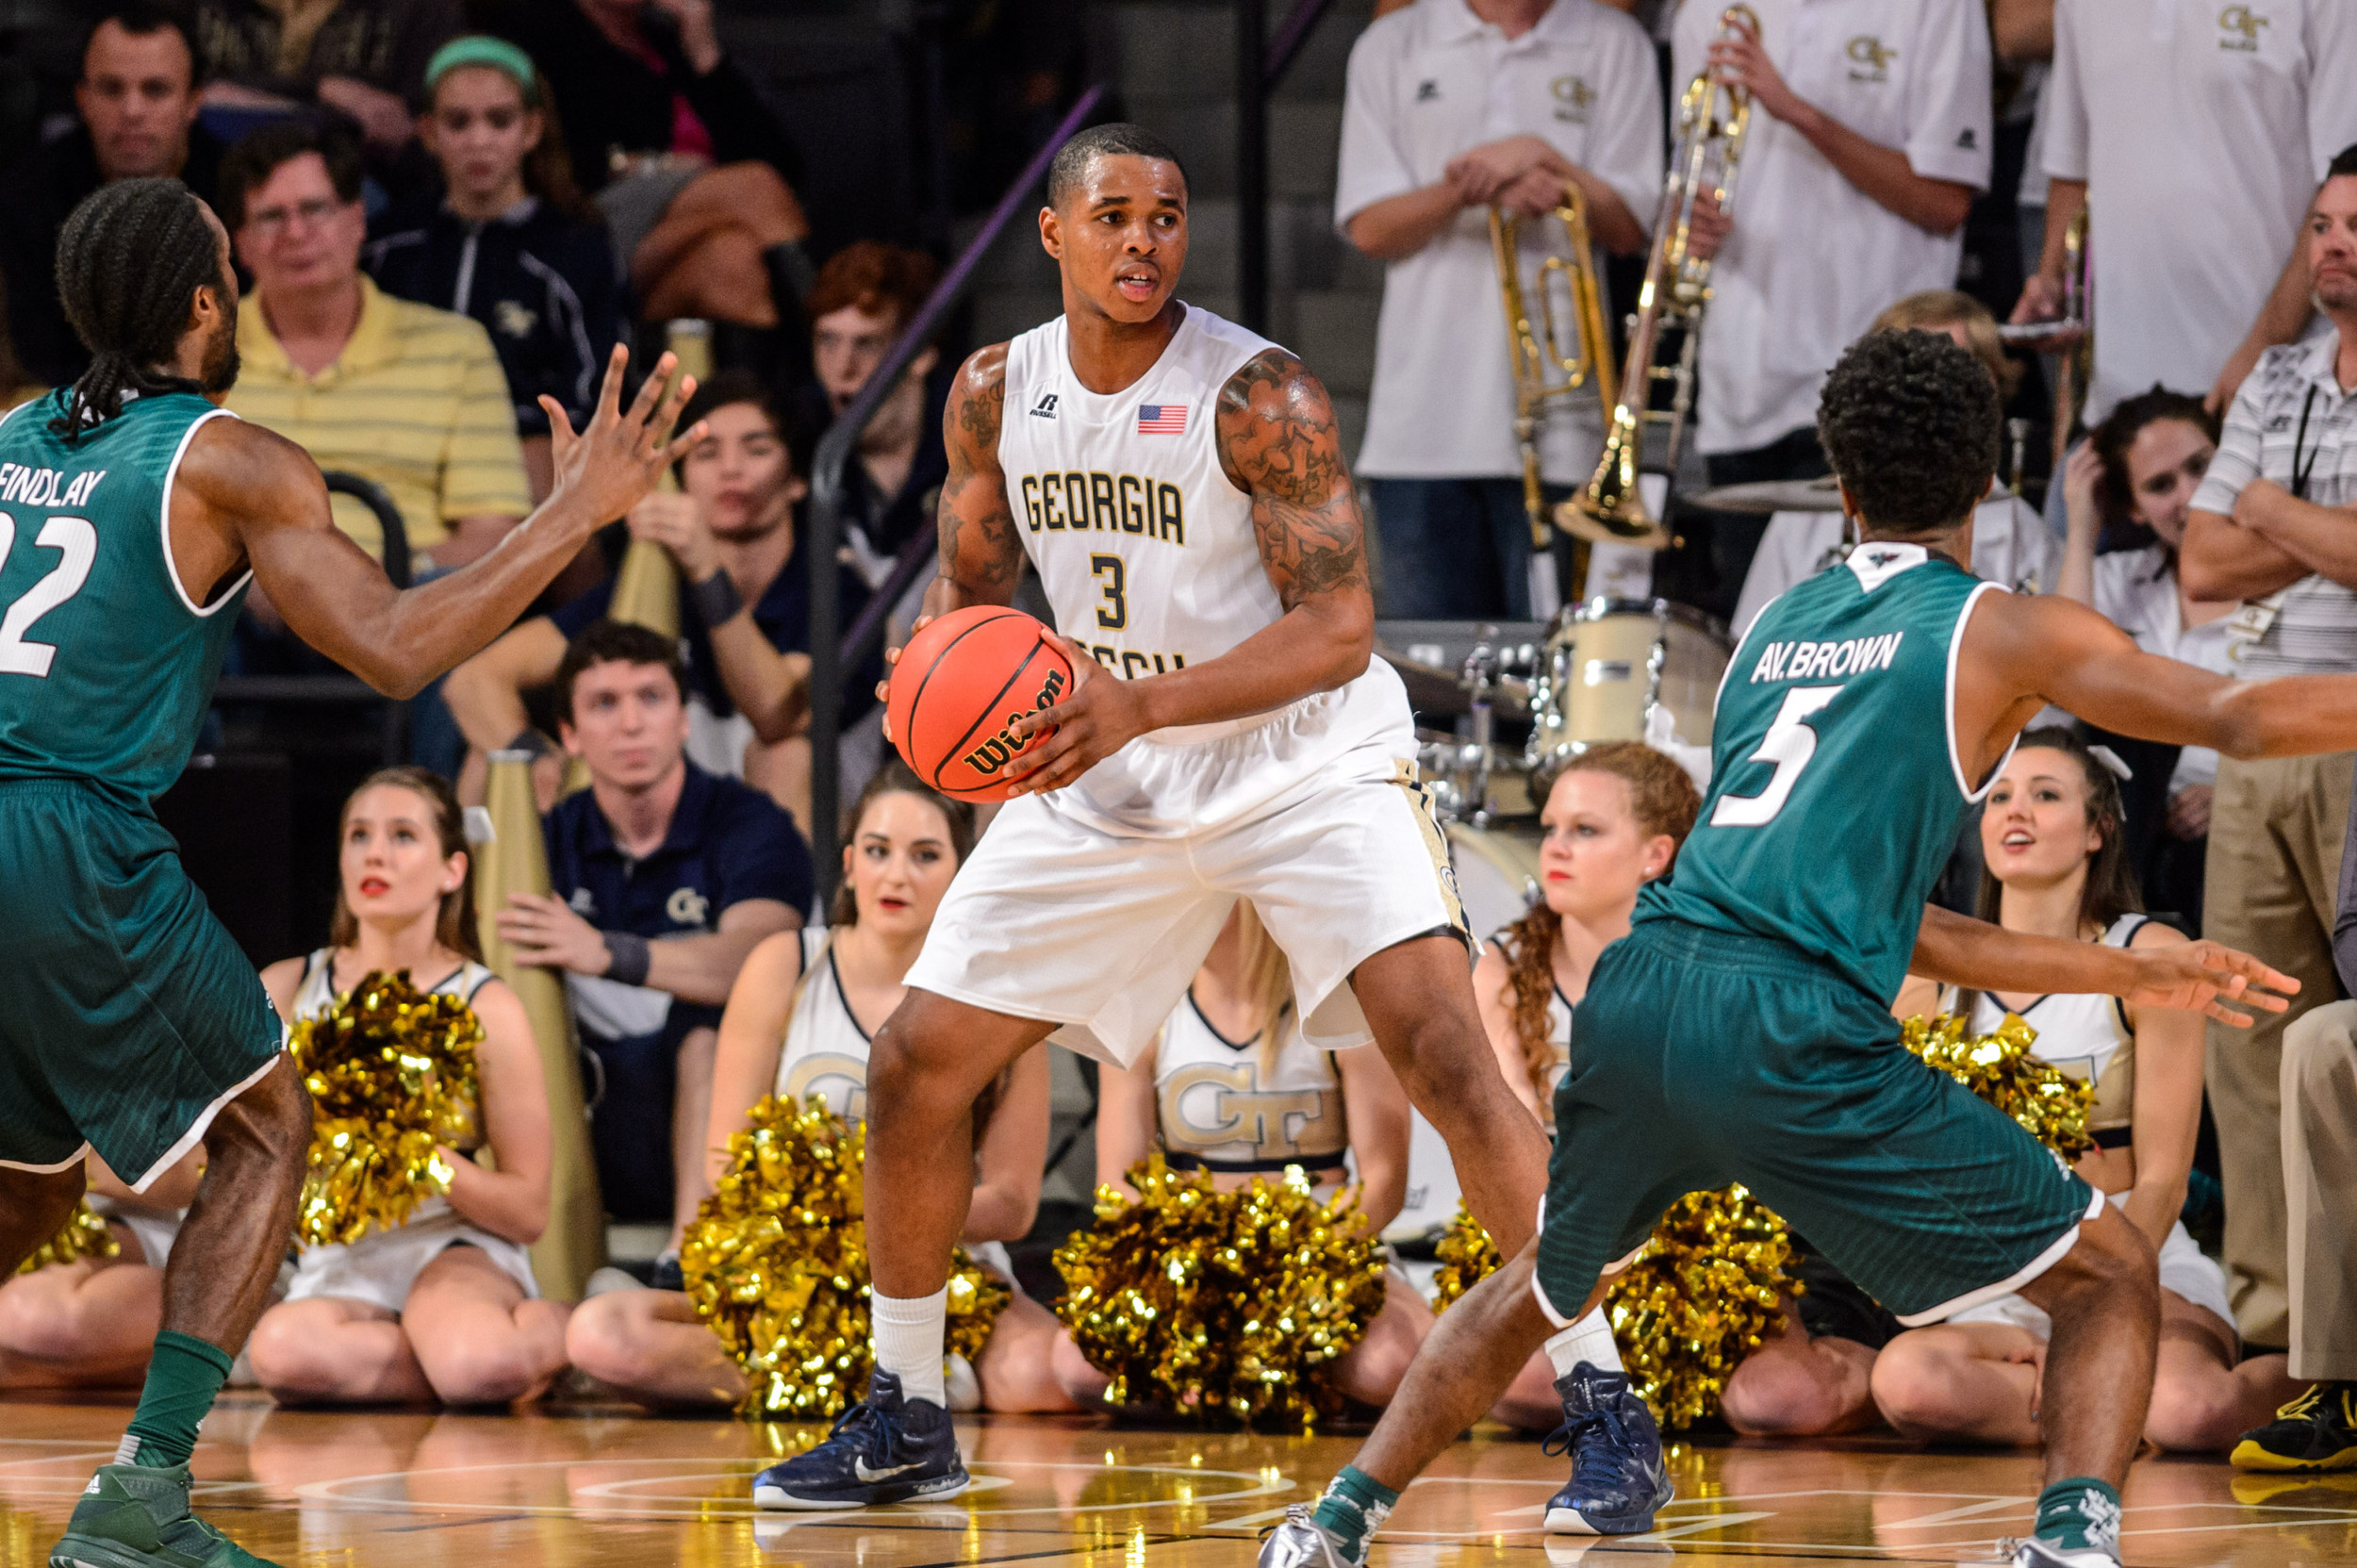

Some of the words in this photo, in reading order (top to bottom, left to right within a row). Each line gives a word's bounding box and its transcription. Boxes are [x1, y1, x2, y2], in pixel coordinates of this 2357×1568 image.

[0, 462, 107, 507] FINDLAY
[1021, 470, 1186, 547] GEORGIA
[0, 510, 99, 678] 2
[1089, 553, 1128, 633] 3
[963, 668, 1065, 776] Wilon
[1709, 684, 1846, 828] 5
[1163, 1062, 1322, 1162] GT
